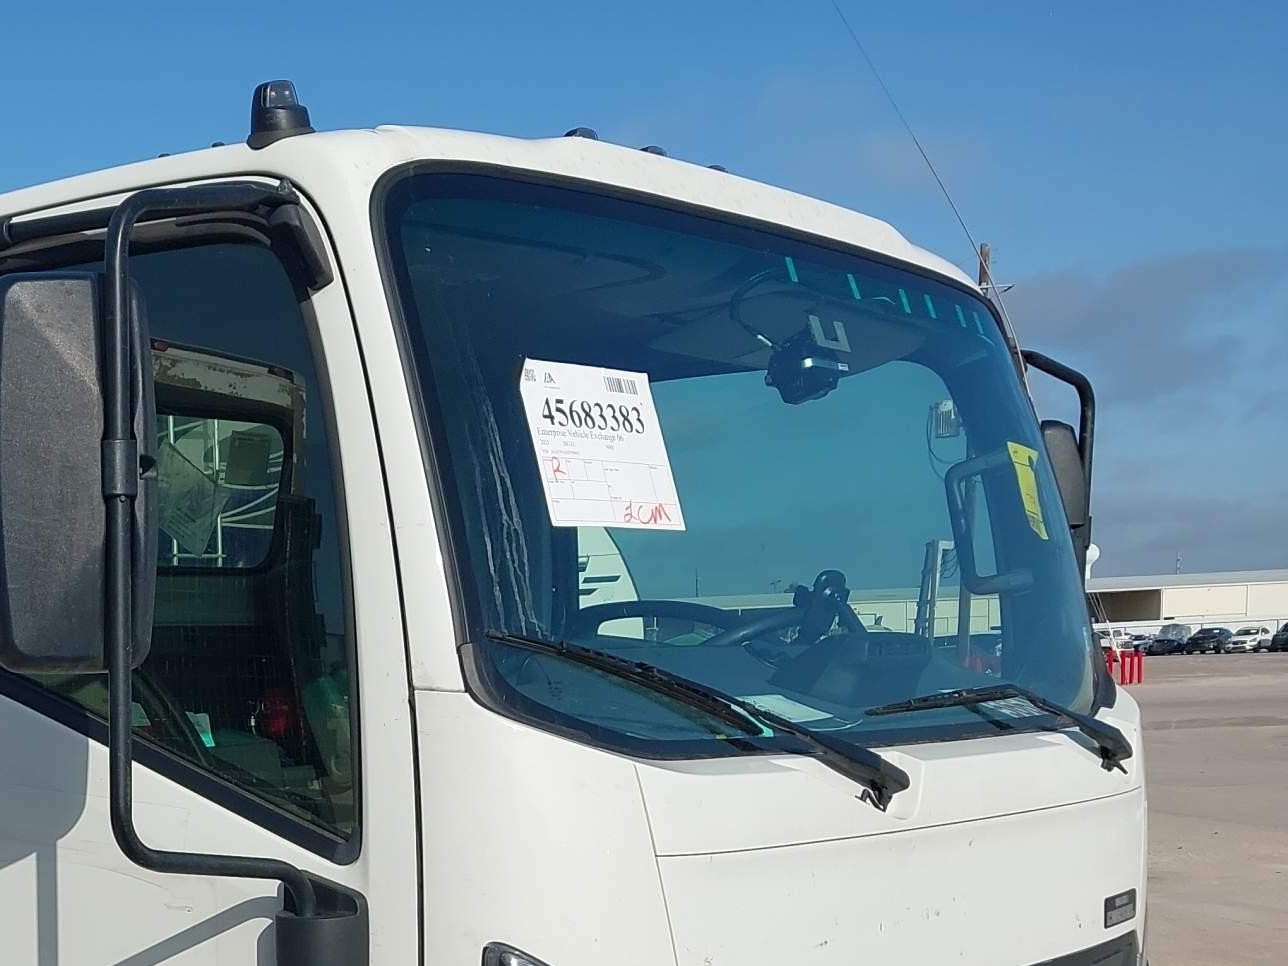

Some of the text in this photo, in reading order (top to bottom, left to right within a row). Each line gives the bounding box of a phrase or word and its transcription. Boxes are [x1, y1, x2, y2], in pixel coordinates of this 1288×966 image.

[542, 397, 645, 434] 45683383
[568, 429, 590, 439] Vehicle
[552, 456, 567, 482] R
